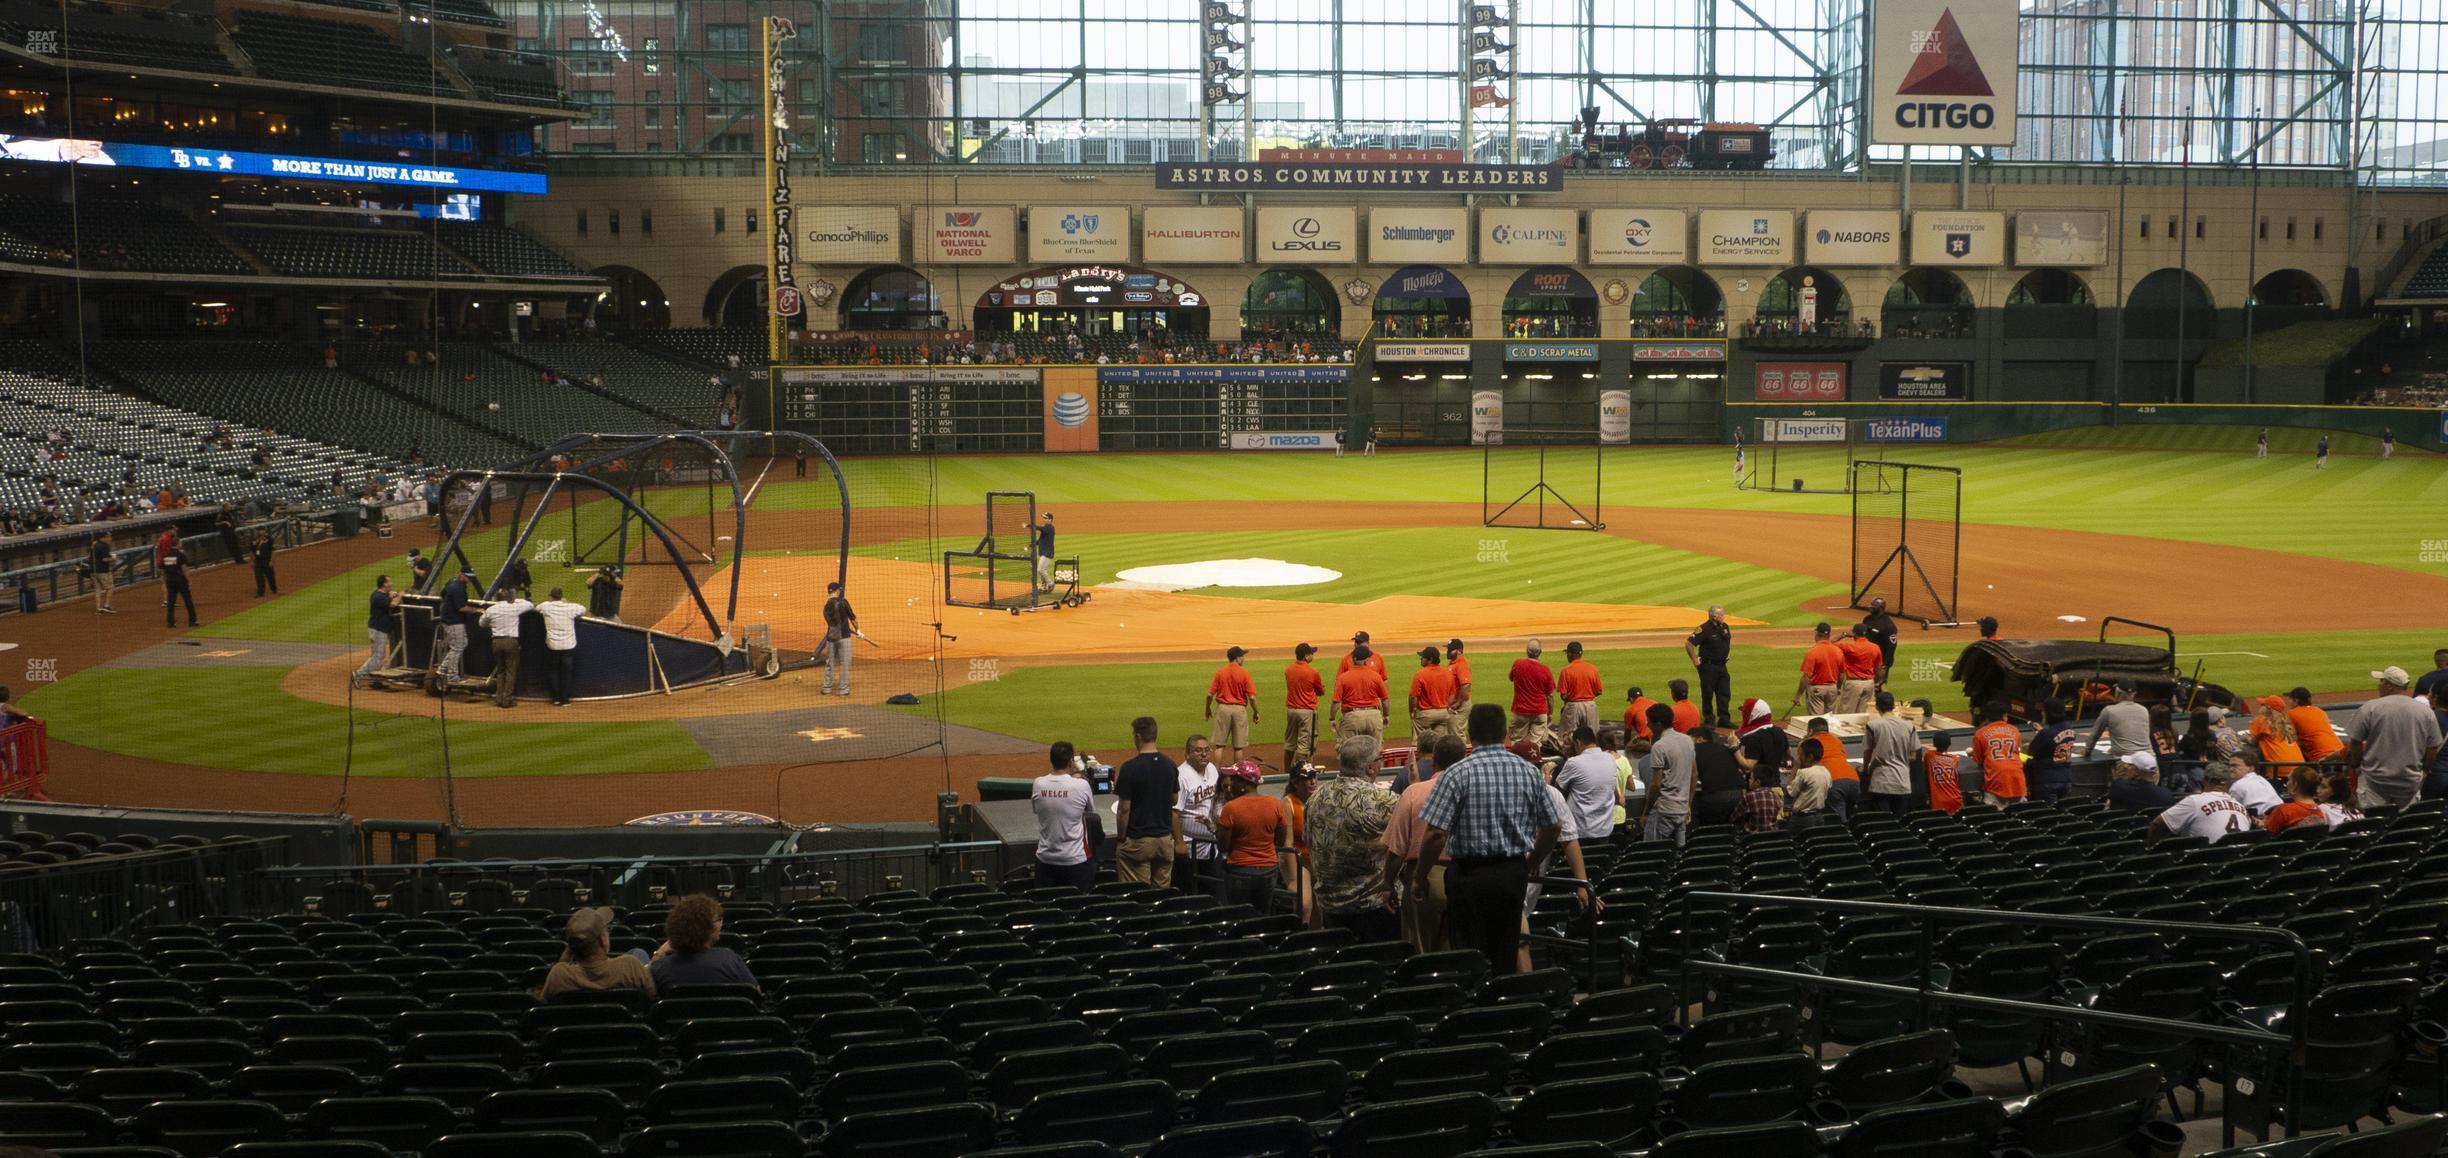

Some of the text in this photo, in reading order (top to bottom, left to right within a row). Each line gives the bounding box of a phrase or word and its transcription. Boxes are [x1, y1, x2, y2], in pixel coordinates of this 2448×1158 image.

[1209, 7, 1223, 18] 80
[1476, 10, 1490, 21] 99
[1209, 34, 1222, 45] 86
[1476, 38, 1490, 48] 01
[1208, 61, 1222, 72] 97
[1476, 62, 1490, 74] 04
[1208, 87, 1222, 98] 98
[1476, 90, 1490, 100] 05
[1895, 102, 1994, 129] CITGO
[272, 159, 459, 184] MORE THAN JUST A GAME.
[1171, 168, 1550, 185] ASTROS COMMUNITY LEADERS
[945, 212, 982, 227] NOV
[809, 231, 889, 244] ConocoPhillips
[1147, 230, 1240, 238] HALLIBURTON
[1382, 226, 1455, 242] Schlumberger
[1513, 230, 1567, 240] CALPINE
[1625, 228, 1651, 237] OXY
[1834, 232, 1890, 243] NABORS
[777, 209, 791, 283] FARE
[1272, 241, 1342, 250] LEXUS
[1712, 235, 1780, 246] CHAMPION
[1062, 266, 1126, 282] Landry's
[1534, 273, 1570, 285] ROOT
[1403, 272, 1444, 292] Montejo
[1381, 347, 1465, 356] HOUSTON CHRONICLE
[1512, 348, 1519, 357] C
[1529, 348, 1537, 357] D
[1540, 348, 1565, 357] SCRAP
[1568, 348, 1592, 357] METAL
[750, 371, 768, 380] 315
[1765, 380, 1780, 389] 66
[1793, 380, 1806, 389] 66
[1821, 380, 1835, 389] 66
[1442, 412, 1463, 421] 362
[1784, 421, 1843, 438] Insperity
[1869, 423, 1942, 439] TexanPlus
[1270, 436, 1320, 445] mazda
[1990, 738, 2015, 760] 27
[1933, 766, 1953, 783] 27
[2201, 800, 2248, 816] SPRINGE
[2225, 814, 2240, 833] 4
[2241, 1080, 2252, 1092] 17
